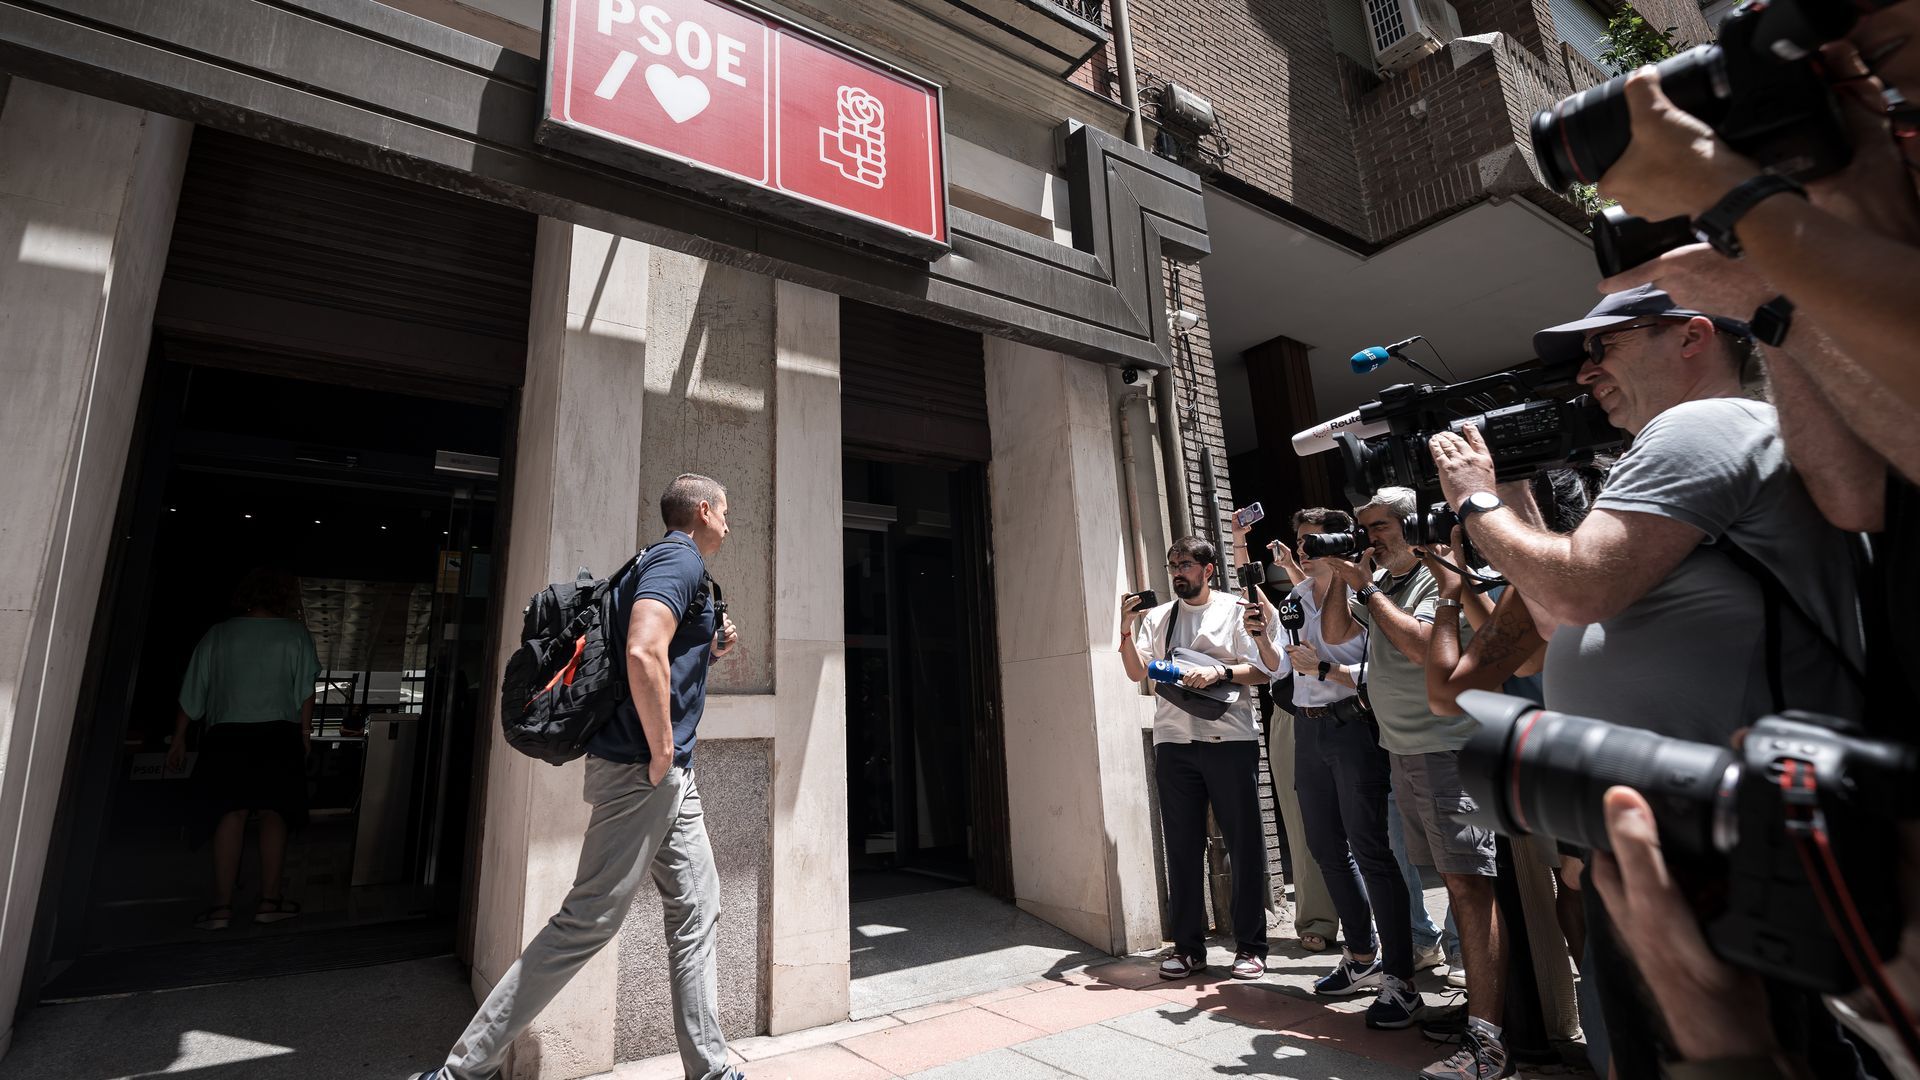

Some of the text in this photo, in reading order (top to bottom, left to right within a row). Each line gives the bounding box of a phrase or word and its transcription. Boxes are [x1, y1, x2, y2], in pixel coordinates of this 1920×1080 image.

[597, 0, 746, 88] PSOE
[1330, 415, 1362, 430] Reute
[1280, 602, 1298, 614] ok
[304, 752, 342, 777] OE
